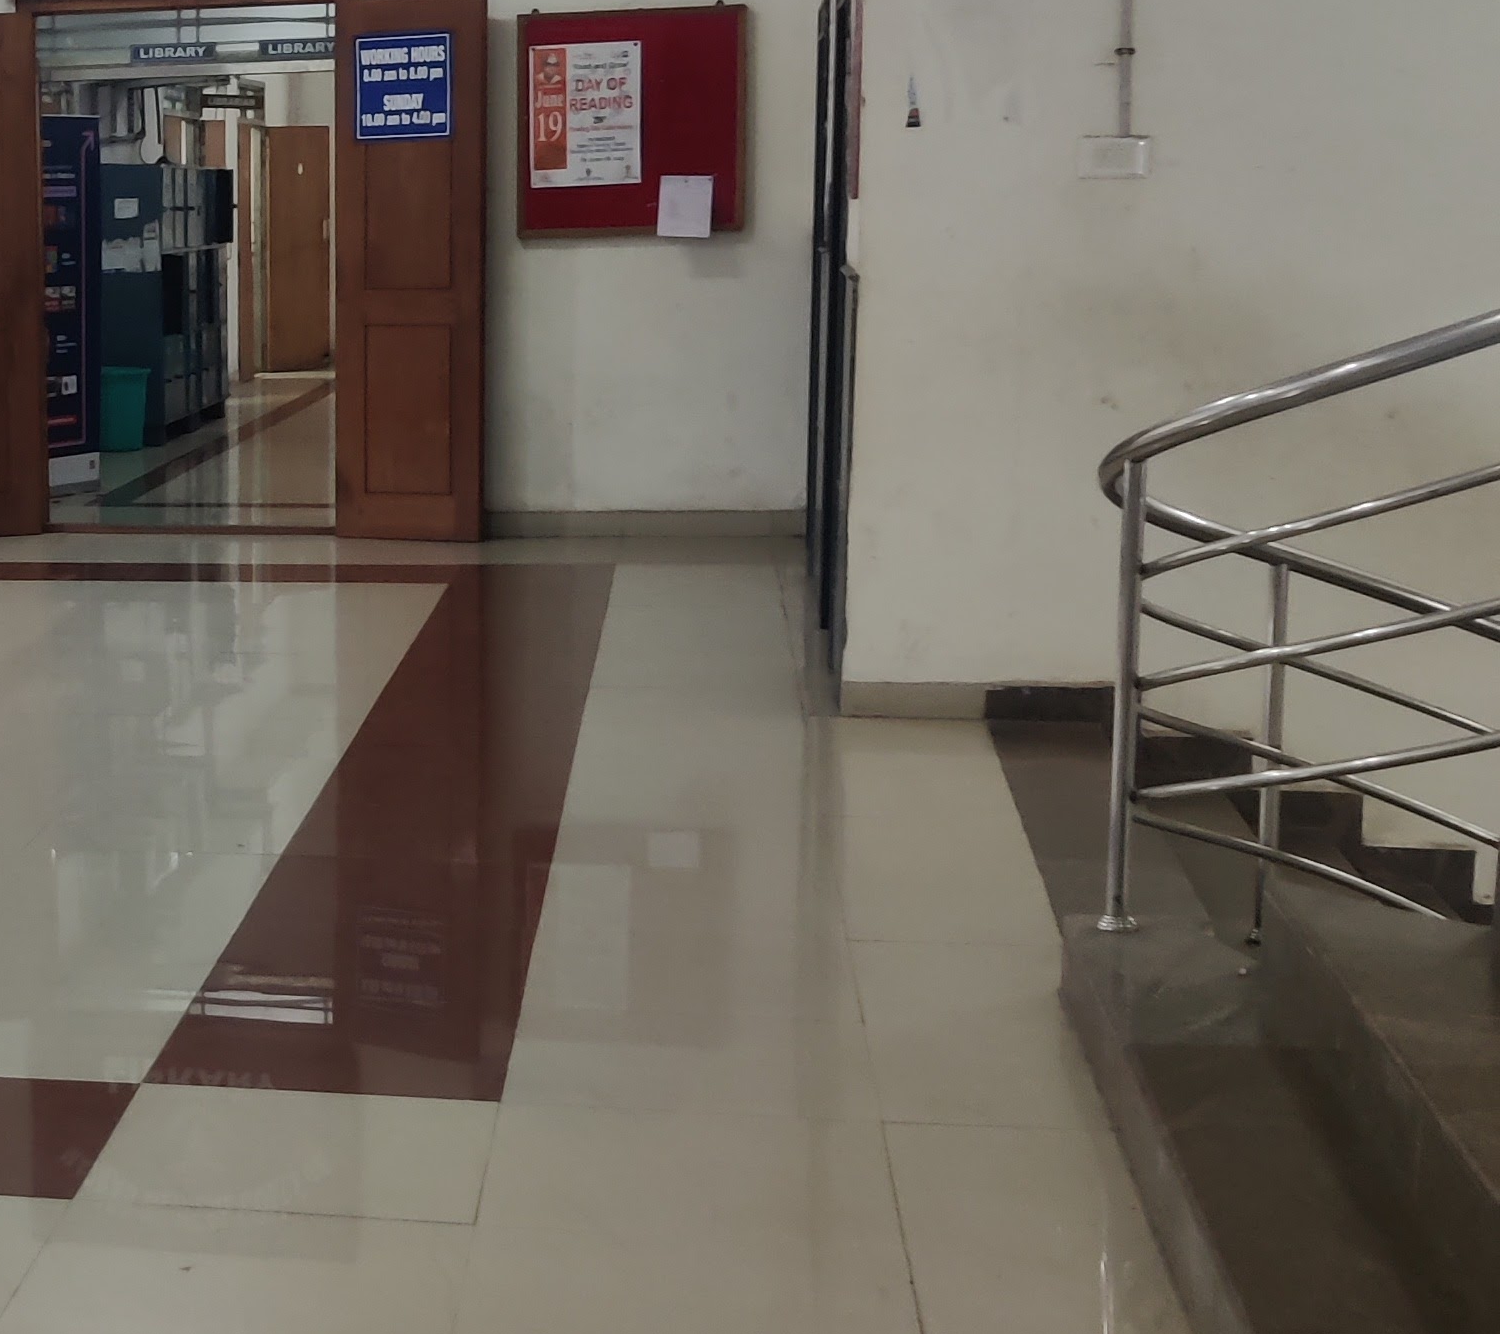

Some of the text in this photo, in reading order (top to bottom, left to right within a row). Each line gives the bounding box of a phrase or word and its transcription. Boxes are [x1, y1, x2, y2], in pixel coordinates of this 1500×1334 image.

[139, 46, 206, 59] LIBRARY
[268, 42, 335, 55] LIBRARY
[360, 45, 445, 65] WORKING HOURS
[575, 77, 627, 92] DAY OF
[383, 93, 424, 111] SUNDAY
[535, 91, 564, 108] June
[570, 95, 633, 111] READING
[538, 111, 562, 142] 19
